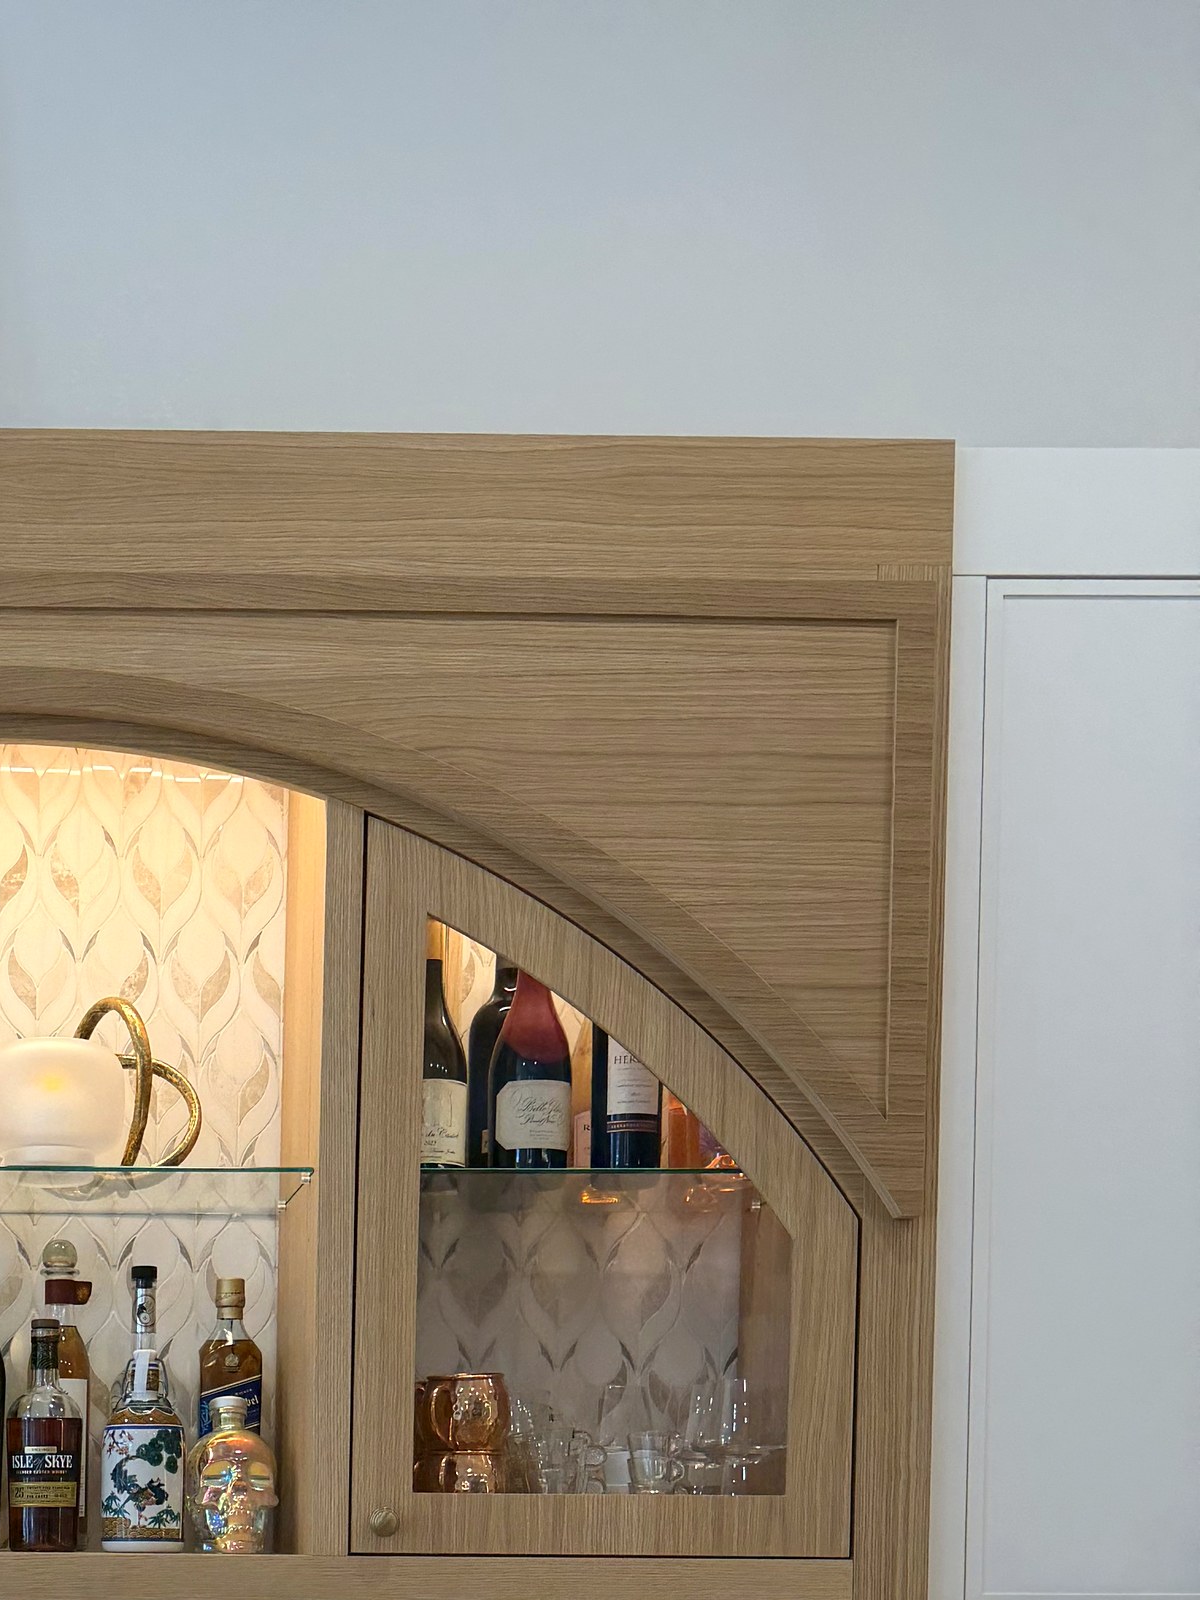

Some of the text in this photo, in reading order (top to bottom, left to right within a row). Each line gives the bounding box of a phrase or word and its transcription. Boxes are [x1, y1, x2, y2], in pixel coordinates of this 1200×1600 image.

[245, 1395, 260, 1407] bel
[12, 1454, 34, 1469] ISLE
[44, 1454, 73, 1469] SKYE
